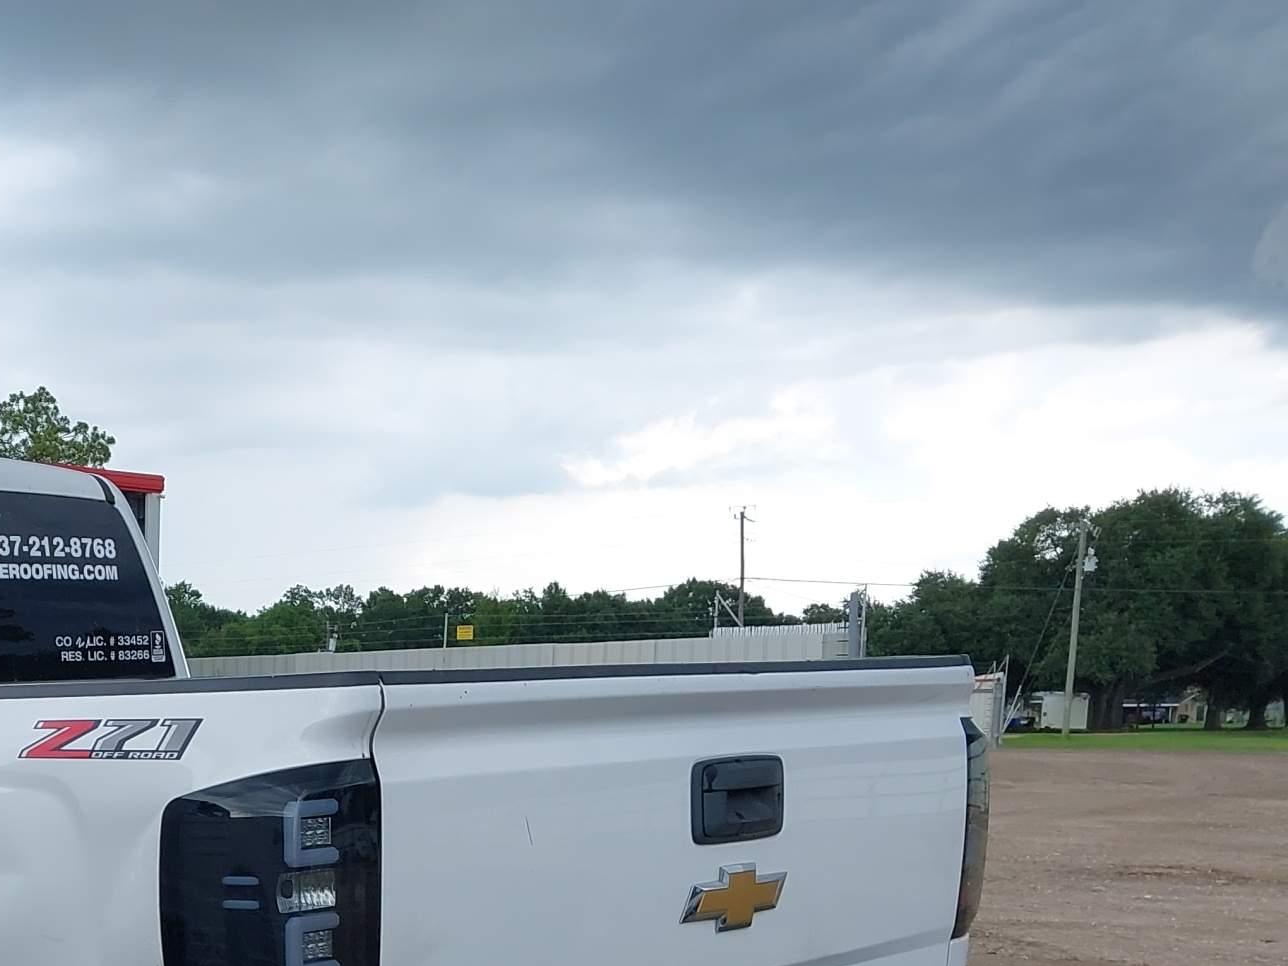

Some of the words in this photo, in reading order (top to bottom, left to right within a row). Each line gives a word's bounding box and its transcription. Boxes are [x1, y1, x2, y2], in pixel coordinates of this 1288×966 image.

[117, 635, 149, 646] 33452
[61, 651, 85, 661] RES.
[87, 651, 107, 661] LIC.
[118, 650, 150, 660] 83266
[17, 718, 204, 760] Z71
[91, 751, 125, 759] OFF
[128, 751, 179, 760] ROAD
